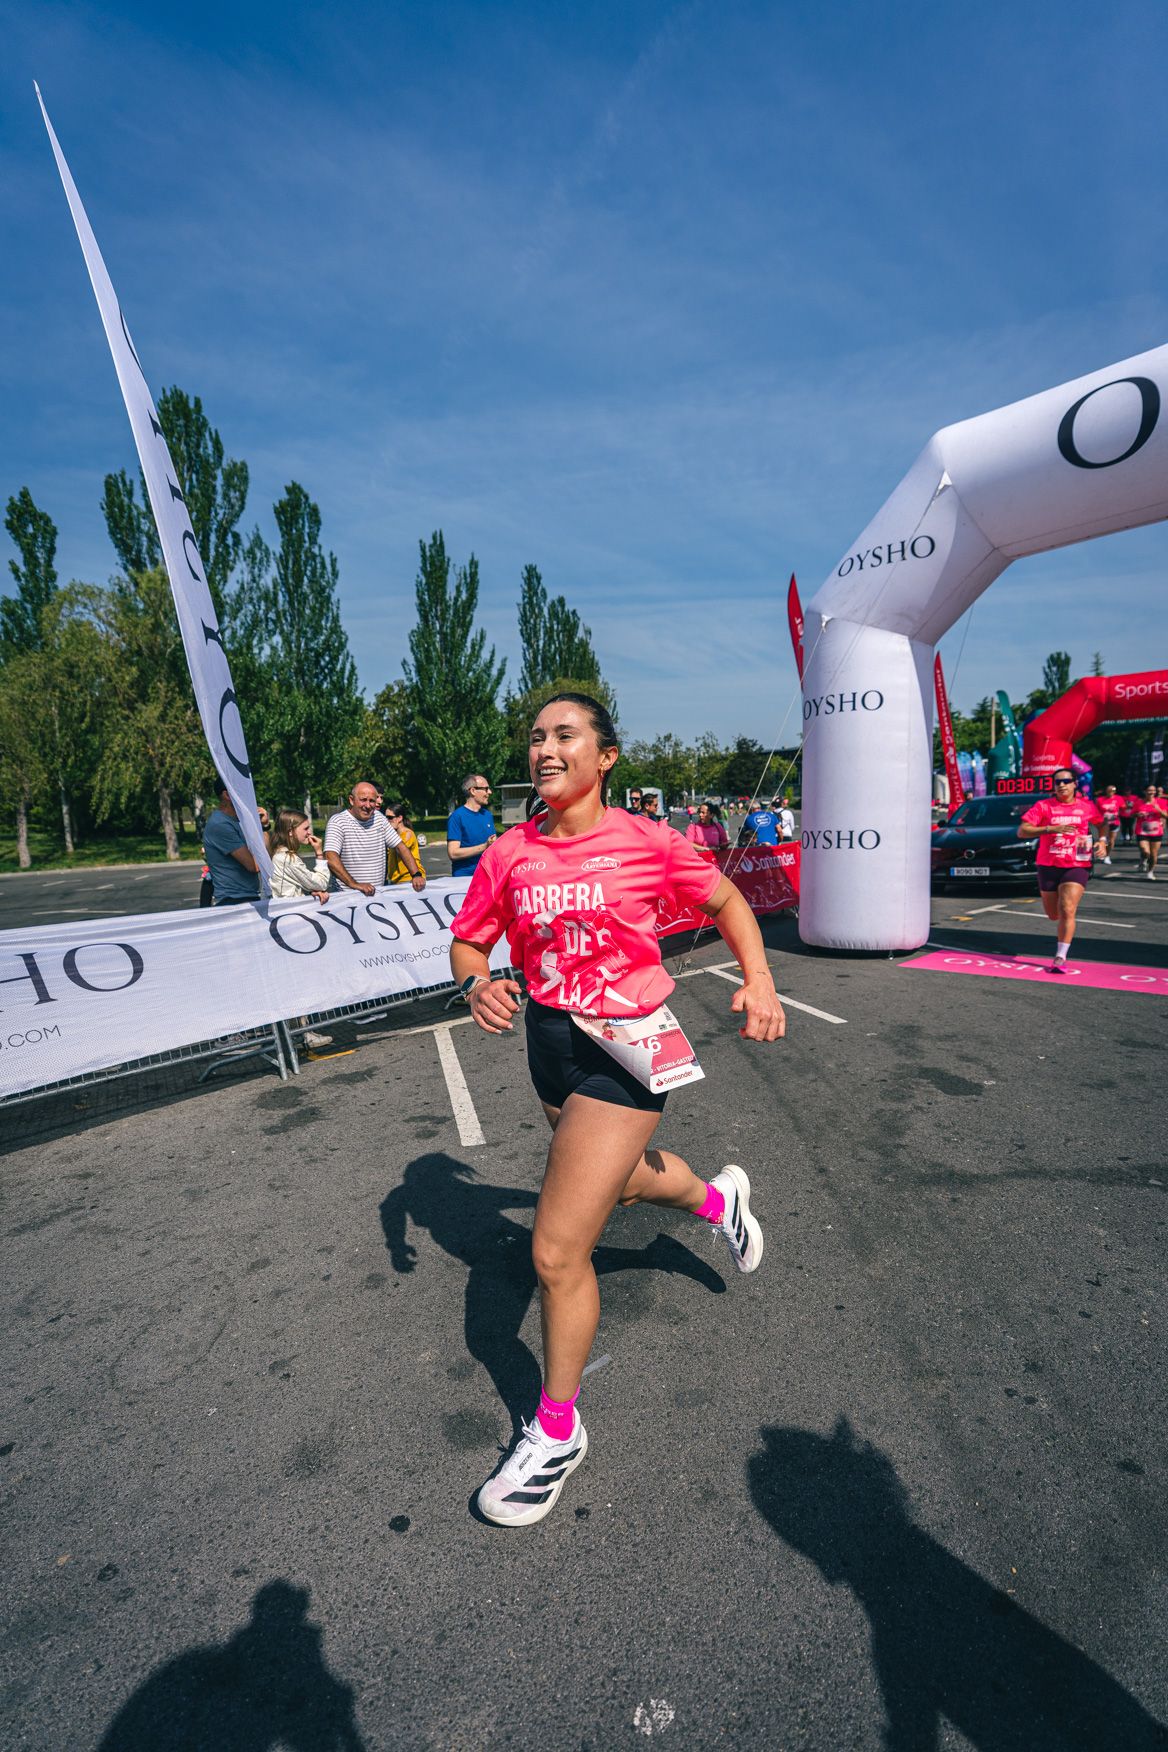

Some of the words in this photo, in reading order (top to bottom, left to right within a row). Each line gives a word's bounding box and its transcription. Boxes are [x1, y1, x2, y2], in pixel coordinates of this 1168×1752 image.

[1057, 376, 1161, 469] O
[837, 535, 935, 577] OYSHO
[1114, 681, 1168, 700] Sports
[803, 690, 884, 720] OYSHO
[802, 829, 880, 850] OYSHO
[753, 852, 796, 871] Santander
[514, 882, 606, 916] CARRERA
[563, 921, 592, 956] DE
[359, 944, 450, 968] WWW.OYSHO.CO
[0, 1025, 61, 1050] .COM
[664, 1070, 692, 1084] Santander
